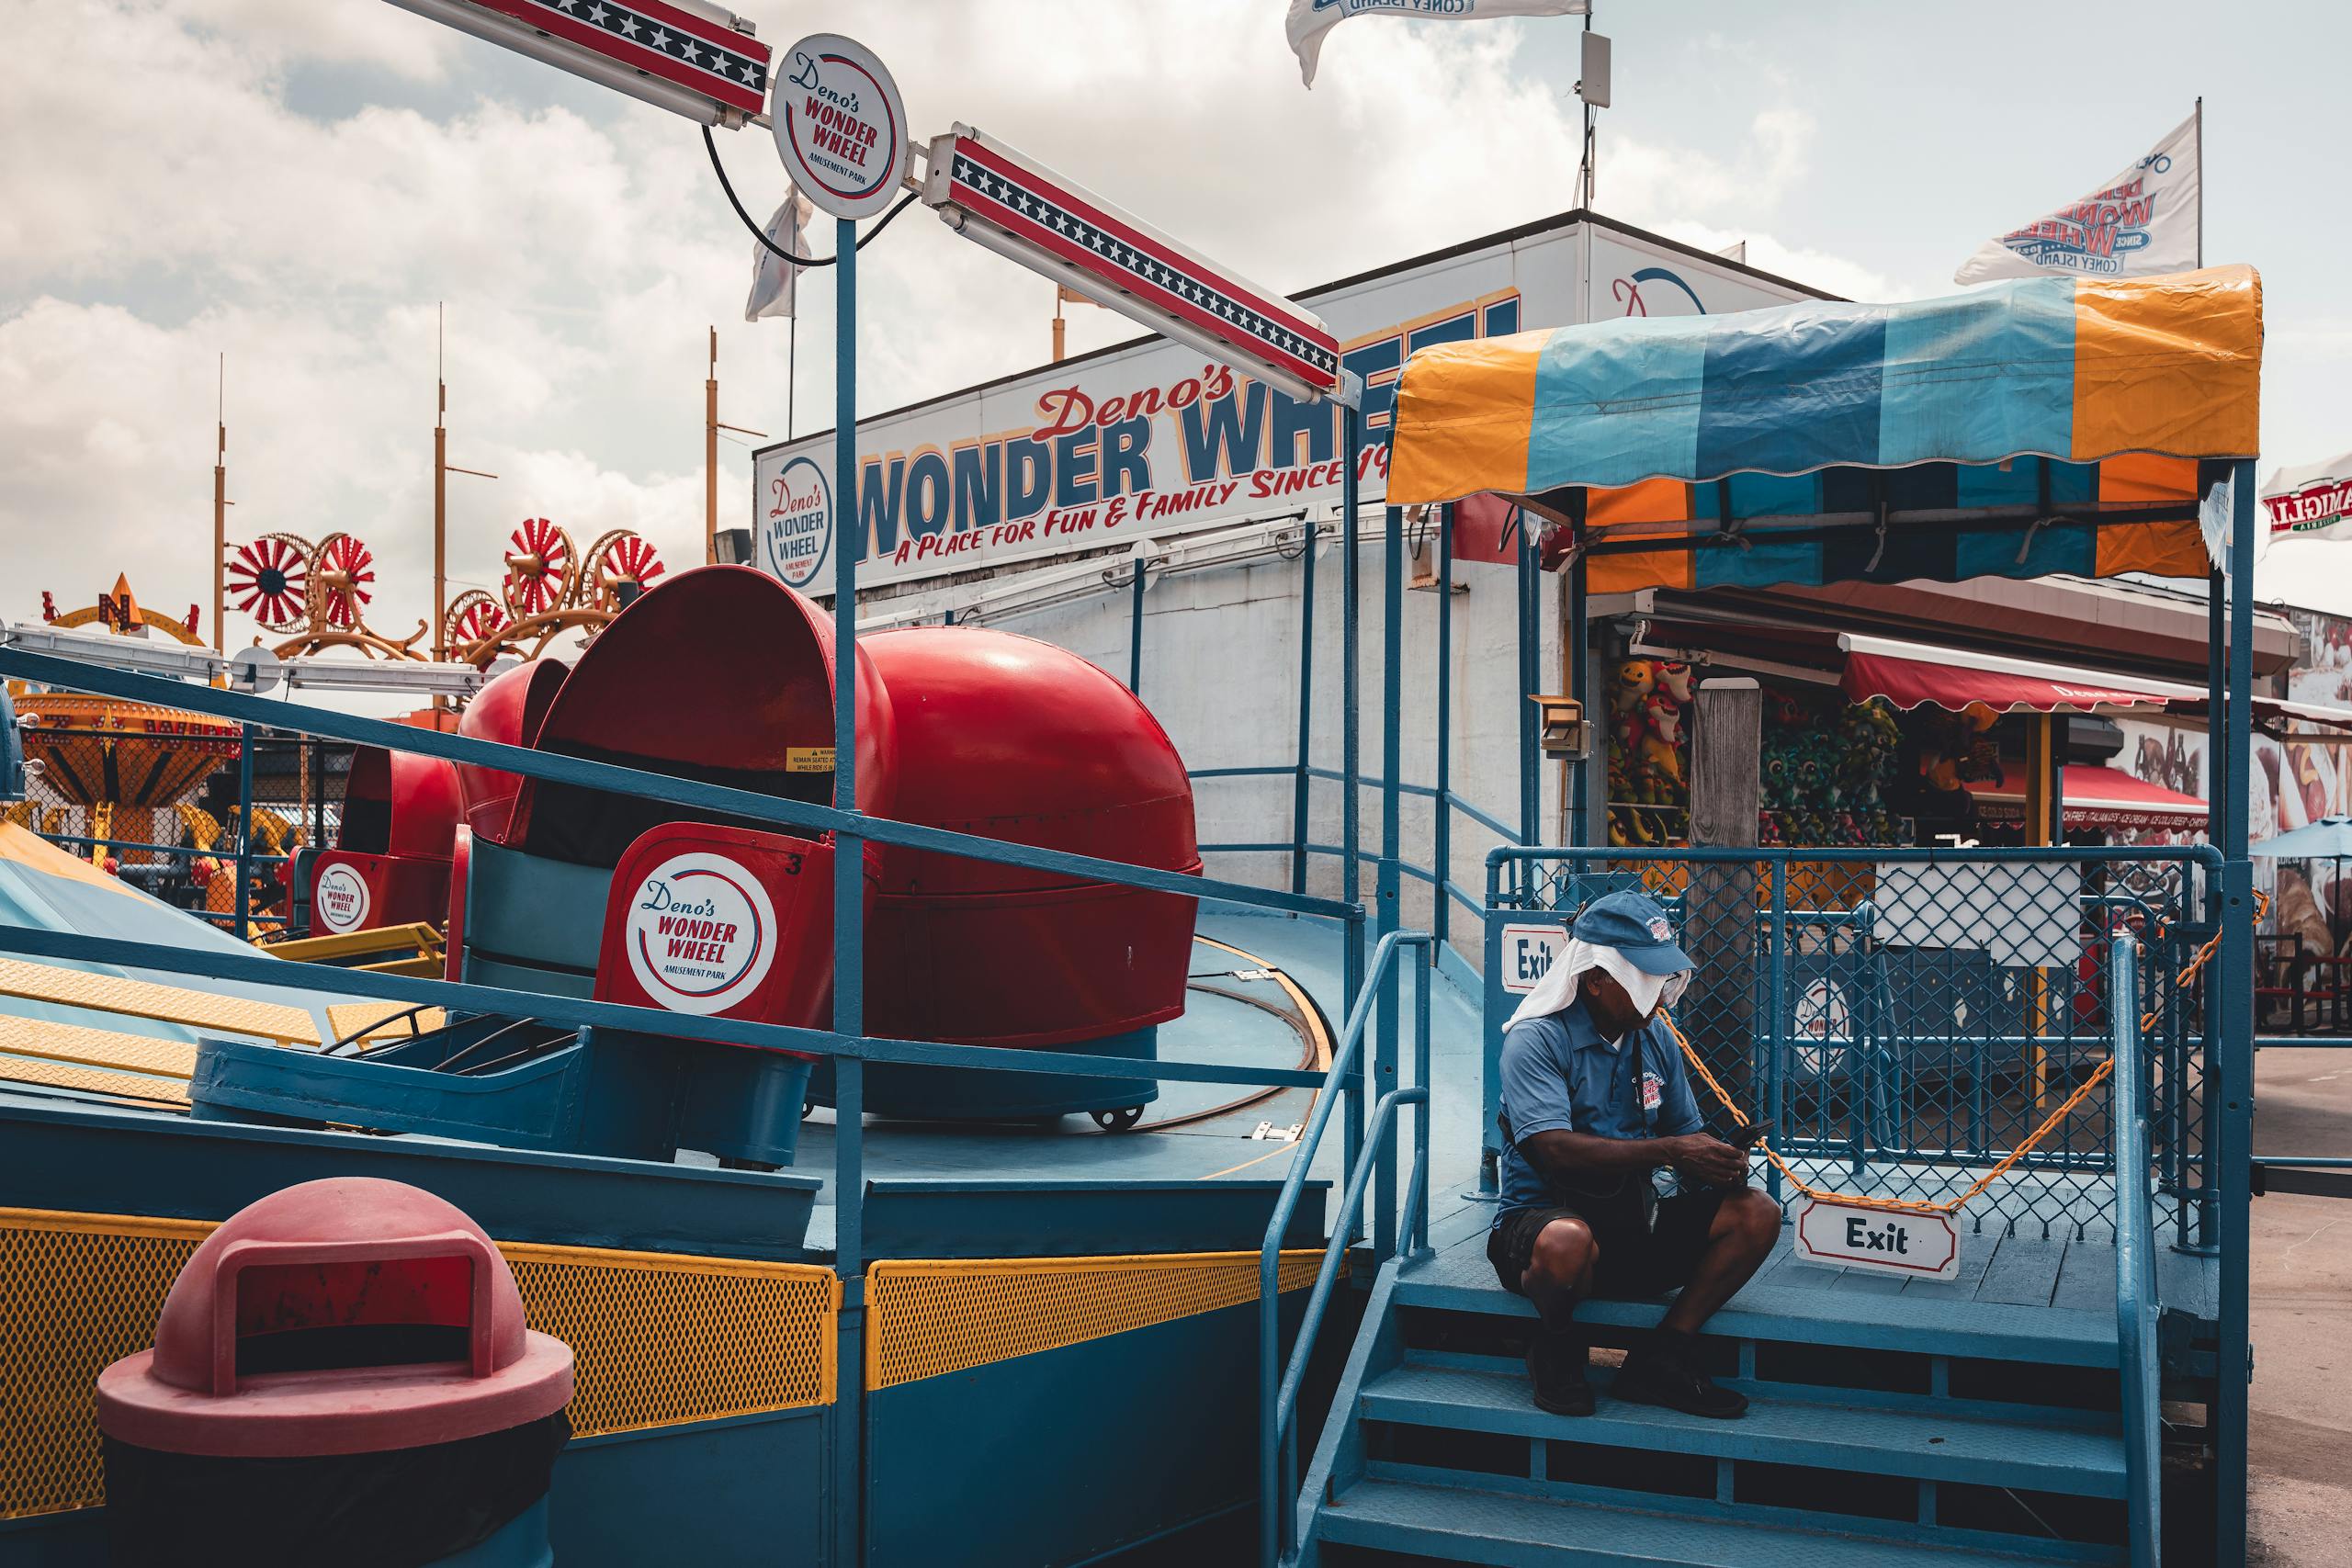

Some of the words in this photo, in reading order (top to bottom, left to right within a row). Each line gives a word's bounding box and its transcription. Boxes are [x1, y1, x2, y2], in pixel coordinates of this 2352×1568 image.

[788, 51, 860, 113] Deno's
[805, 96, 878, 149] WONDER
[812, 124, 866, 168] WHEEL
[808, 152, 849, 178] AMUSEMENT
[848, 169, 867, 186] PARK
[1031, 364, 1234, 443] Deno's
[770, 478, 820, 518] Deno's
[855, 412, 1155, 566] WONDER
[774, 511, 824, 539] WONDER
[894, 540, 910, 566] A
[917, 530, 984, 560] PLACE
[992, 521, 1035, 547] FOR
[1044, 510, 1097, 537] FUN
[1104, 497, 1128, 528] &
[1136, 481, 1238, 521] FAMILY
[1249, 460, 1344, 499] SINCE
[779, 536, 819, 560] WHEEL
[785, 558, 813, 571] AMUSEMENT
[792, 570, 805, 580] PARK
[785, 853, 802, 875] 3
[322, 874, 346, 892] Deno's
[327, 890, 355, 903] WONDER
[331, 900, 351, 912] WHEEL
[640, 880, 715, 917] Deno's
[658, 915, 738, 943] WONDER
[666, 938, 726, 964] WHEEL
[662, 964, 706, 978] AMUSEMENT
[706, 969, 727, 980] PARK
[1846, 1217, 1909, 1255] Exit
